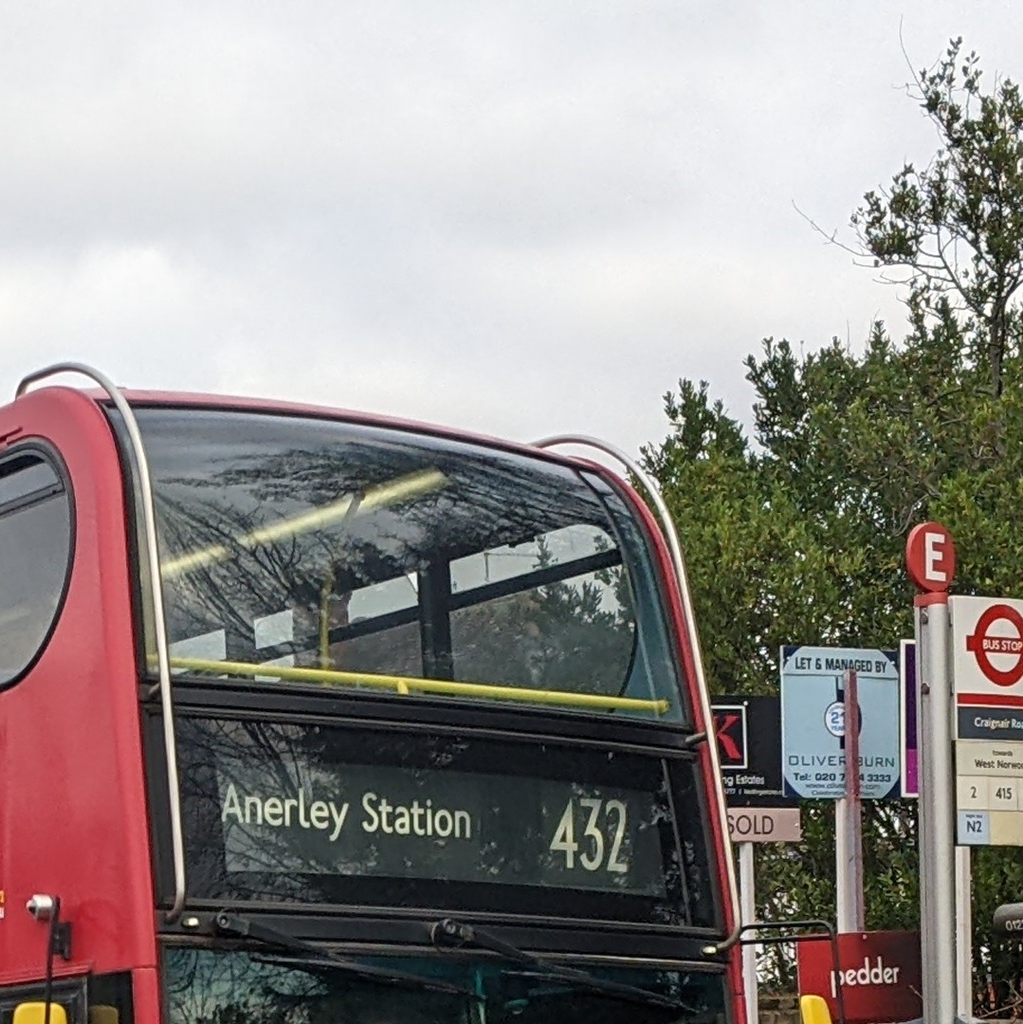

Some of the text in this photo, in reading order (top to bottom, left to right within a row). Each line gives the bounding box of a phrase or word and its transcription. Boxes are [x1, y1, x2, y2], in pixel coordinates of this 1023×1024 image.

[925, 532, 946, 581] E
[982, 639, 1023, 651] BUS STOP
[795, 657, 887, 673] LET & MANAGED BY
[974, 716, 1023, 730] Craignair Roa
[788, 755, 847, 767] OLIVER
[975, 758, 995, 769] West
[735, 774, 765, 785] Estates
[815, 773, 836, 782] 020
[867, 774, 892, 782] 3333
[970, 786, 977, 799] 2
[996, 787, 1013, 800] 415
[221, 784, 629, 872] Anerley Station 432
[728, 814, 774, 836] SOLD
[967, 820, 983, 833] N2
[831, 956, 900, 998] pedder
